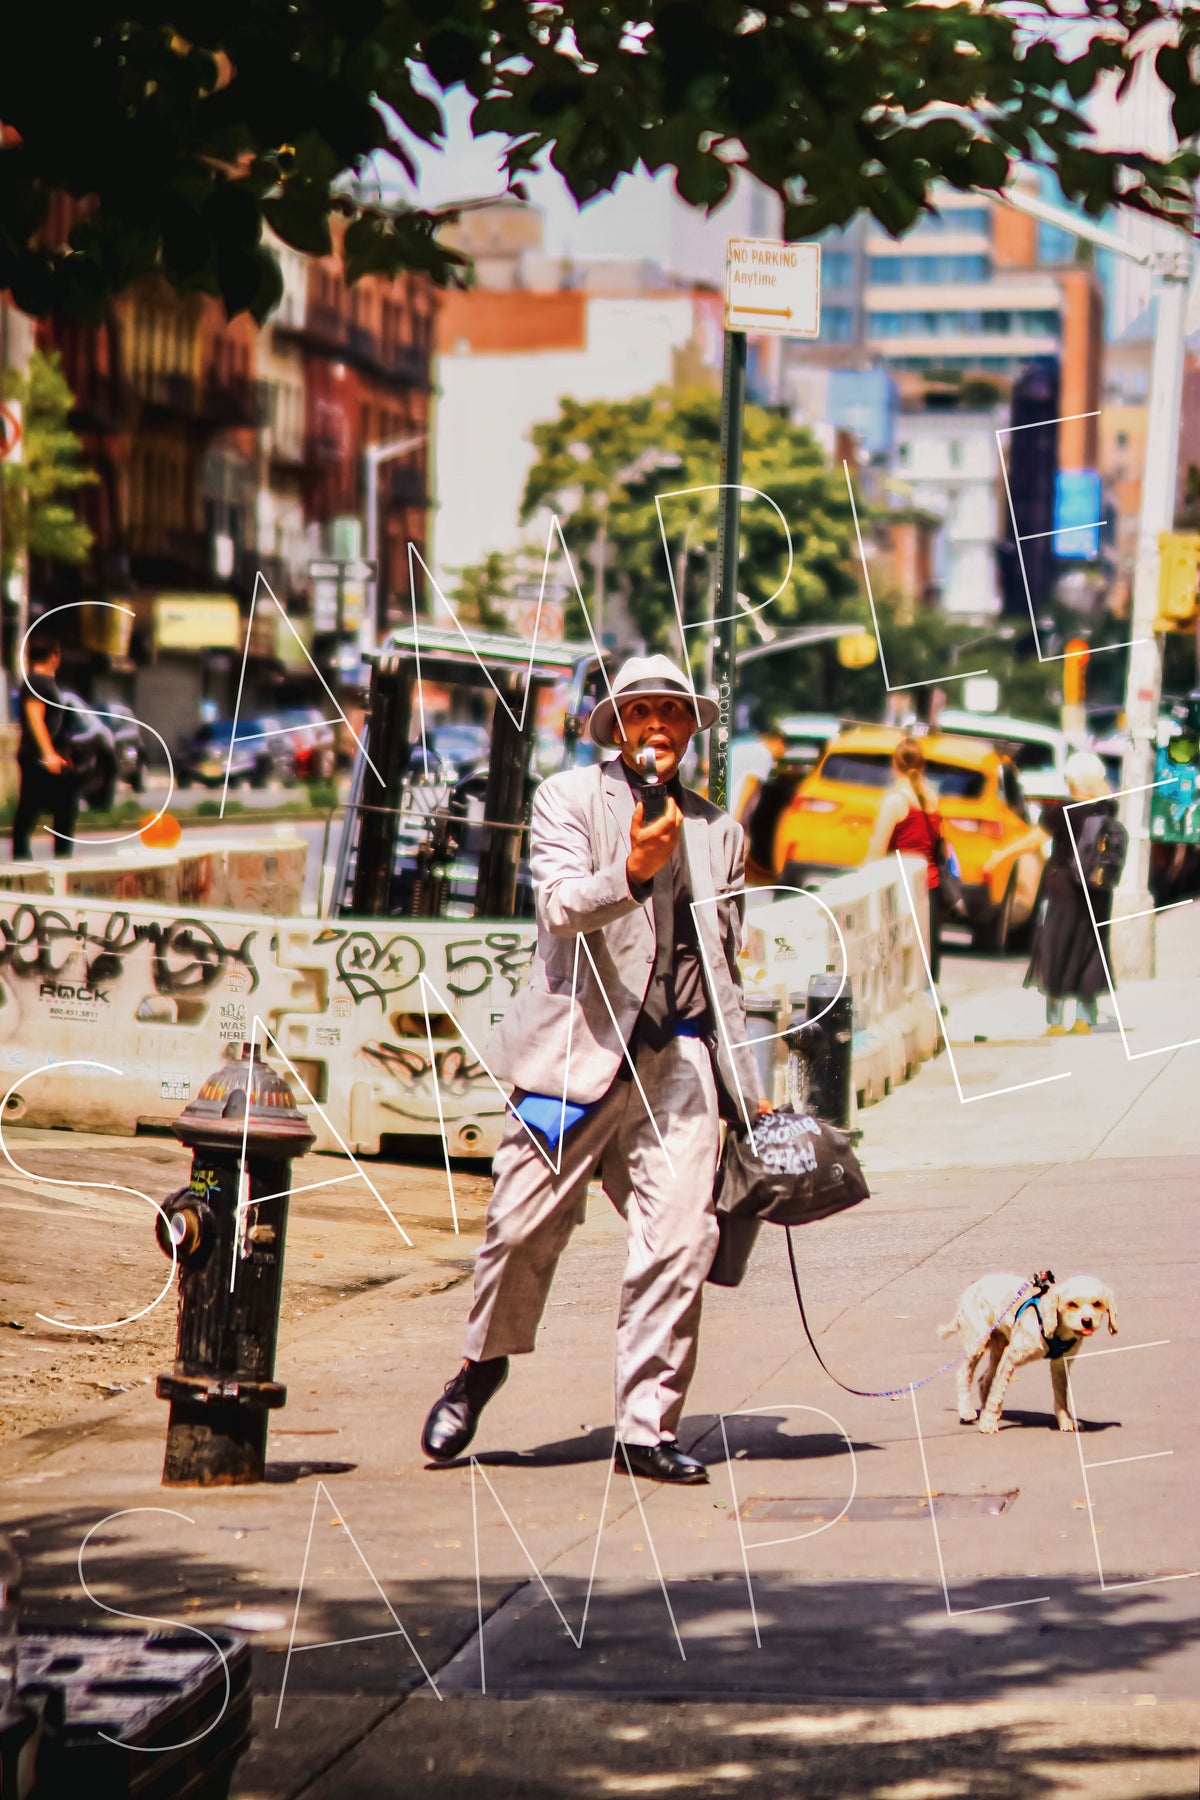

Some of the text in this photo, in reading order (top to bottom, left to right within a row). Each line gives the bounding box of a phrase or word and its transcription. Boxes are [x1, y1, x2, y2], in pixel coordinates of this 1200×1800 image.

[733, 248, 798, 268] NO PARKING
[734, 268, 777, 288] Anytime
[40, 984, 110, 1003] ROCK
[219, 1031, 247, 1040] HERE
[221, 1021, 247, 1031] WAS
